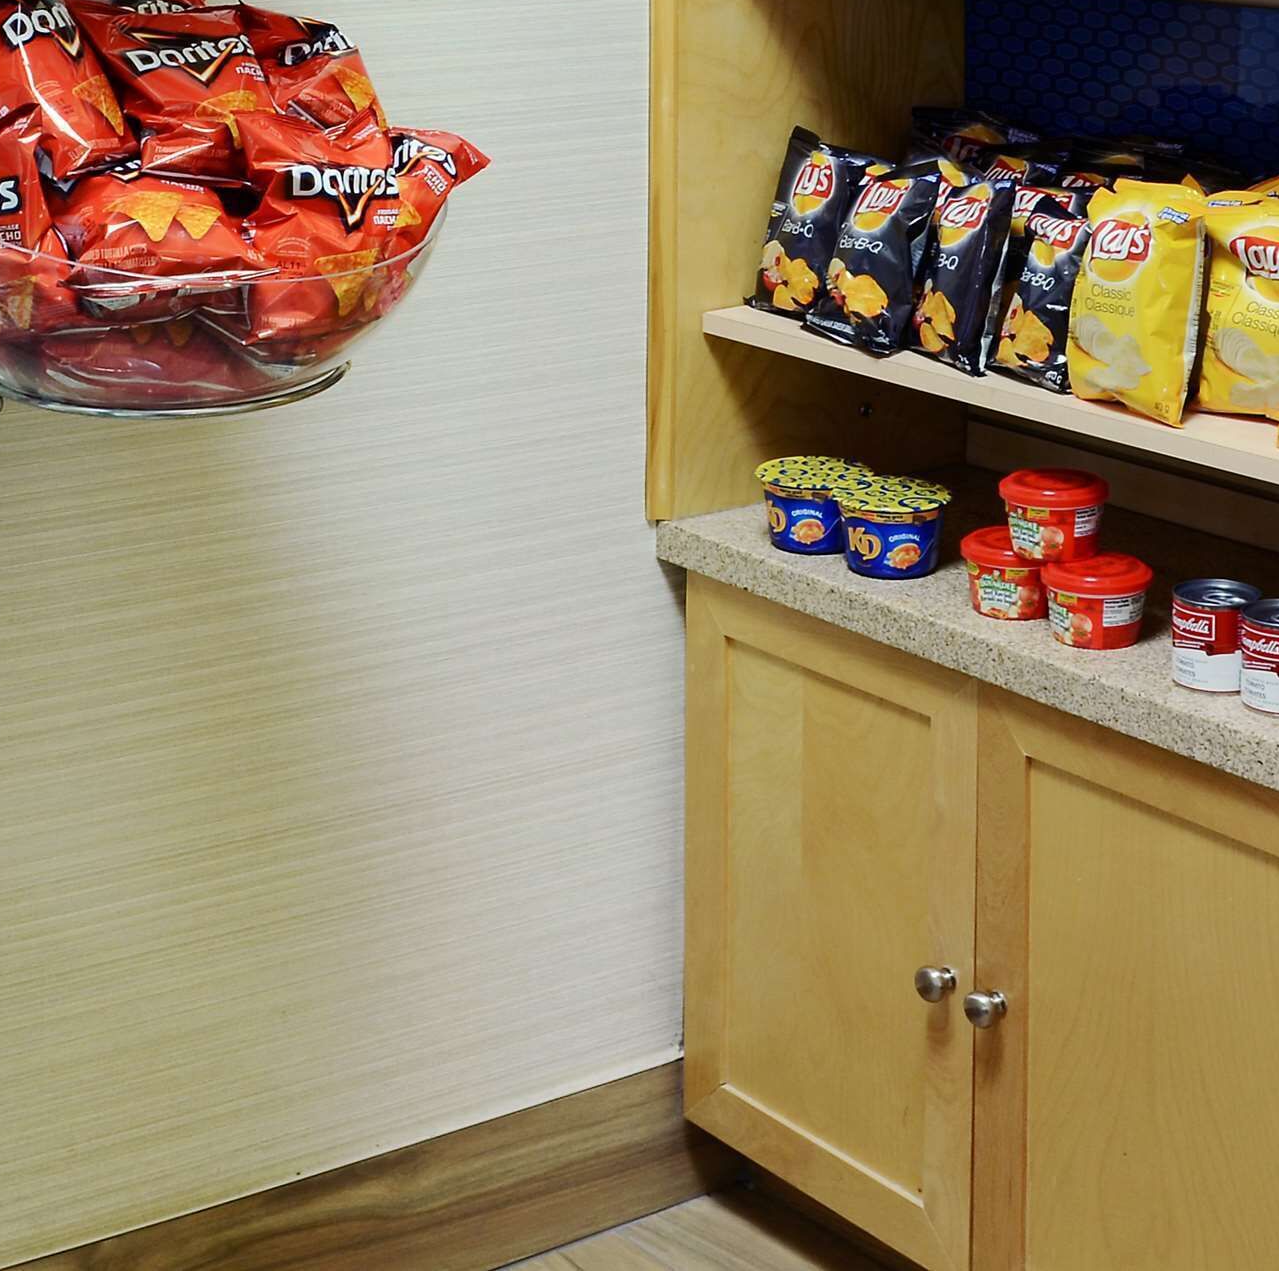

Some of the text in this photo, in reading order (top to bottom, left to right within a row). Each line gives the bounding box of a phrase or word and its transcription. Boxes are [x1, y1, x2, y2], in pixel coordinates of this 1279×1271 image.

[1, 1, 76, 48] Dori
[126, 33, 257, 73] Doritos
[393, 138, 457, 177] ritos
[290, 164, 401, 197] Doritos
[1091, 221, 1152, 261] Lay's
[1084, 297, 1135, 318] Classique
[1090, 283, 1132, 302] Classic
[790, 508, 824, 519] ORIGINAL
[848, 526, 882, 561] KD
[888, 534, 921, 543] ORIGINAL
